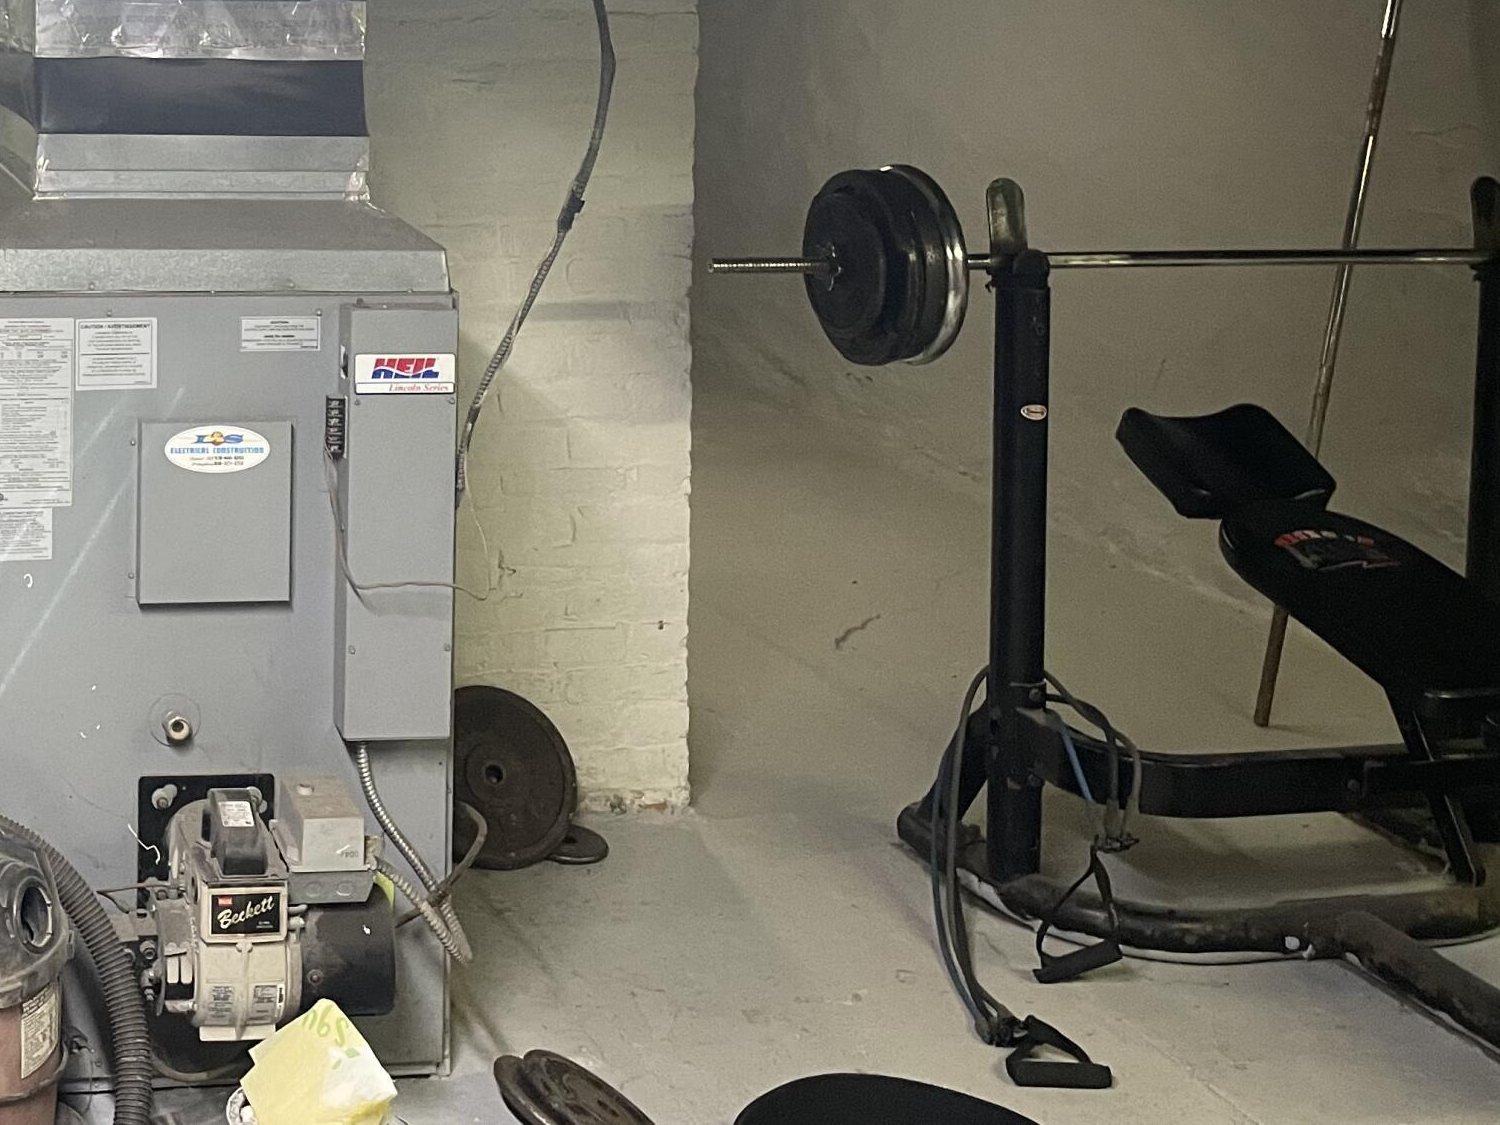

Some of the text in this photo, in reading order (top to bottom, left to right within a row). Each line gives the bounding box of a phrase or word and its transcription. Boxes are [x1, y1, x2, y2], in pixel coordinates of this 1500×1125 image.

[372, 358, 439, 379] HEIL
[389, 382, 449, 392] Lincoln Series
[217, 896, 274, 929] Beckett
